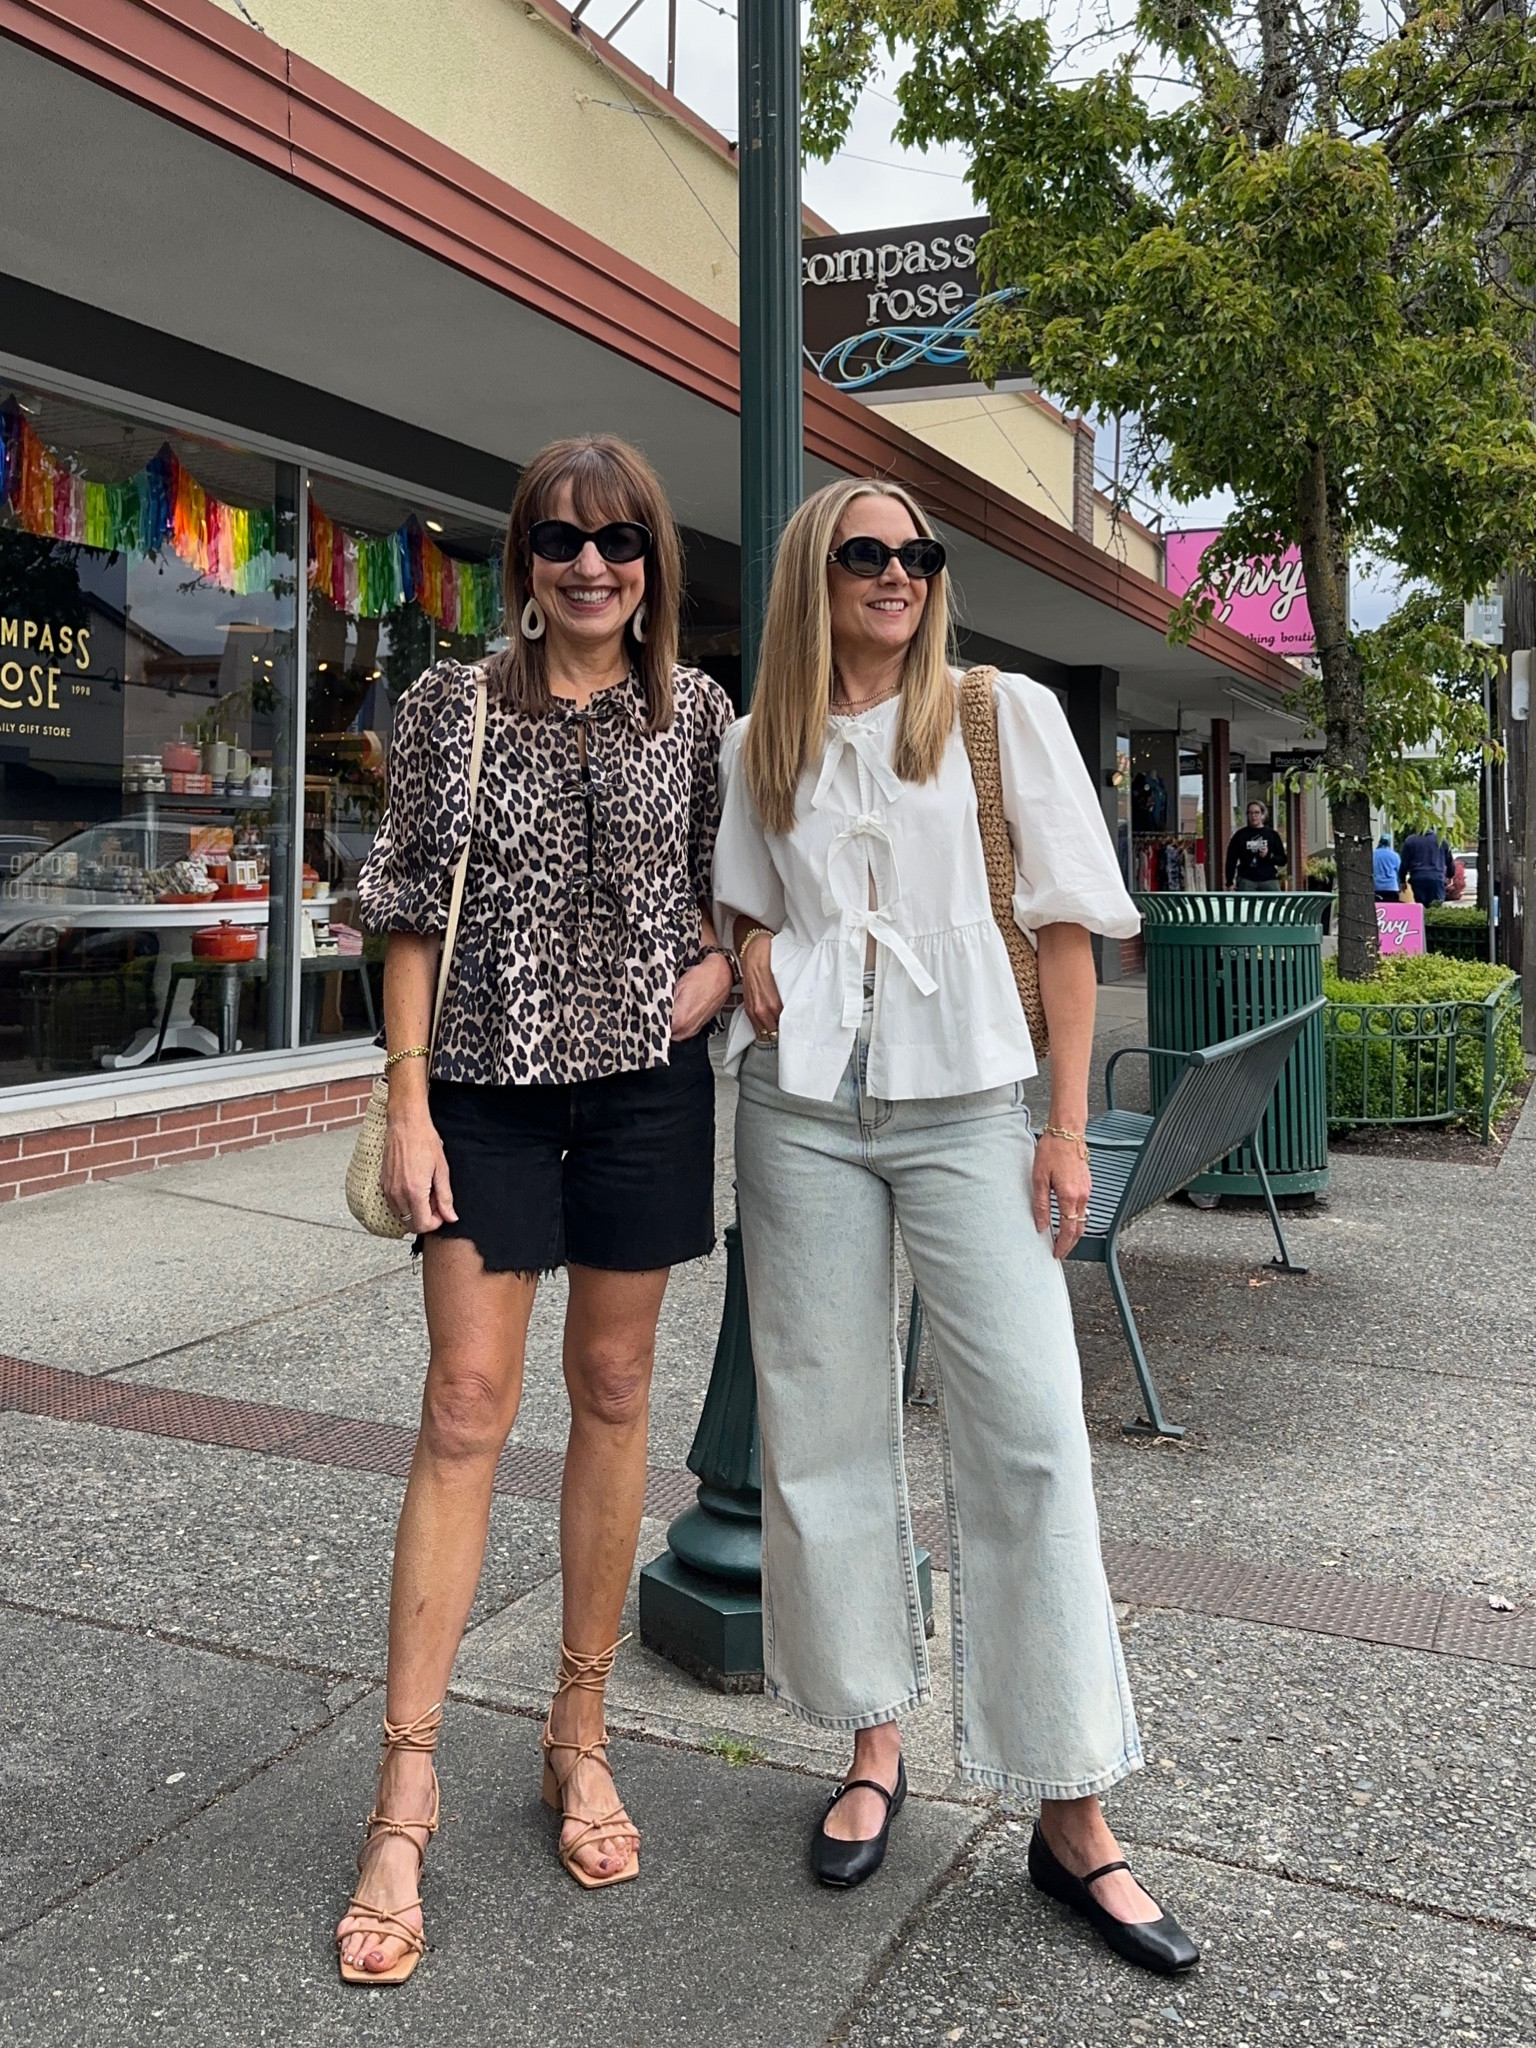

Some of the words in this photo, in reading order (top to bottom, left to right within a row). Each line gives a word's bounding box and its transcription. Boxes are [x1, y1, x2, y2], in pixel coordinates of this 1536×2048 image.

[866, 281, 964, 325] rose
[1, 617, 90, 669] MPASS
[1247, 633, 1275, 647] hing
[0, 661, 61, 709] OSE
[71, 685, 91, 696] 1998
[0, 722, 16, 733] ILY
[19, 723, 40, 735] GIFT
[42, 725, 71, 737] STORE
[1275, 756, 1303, 765] Proctor
